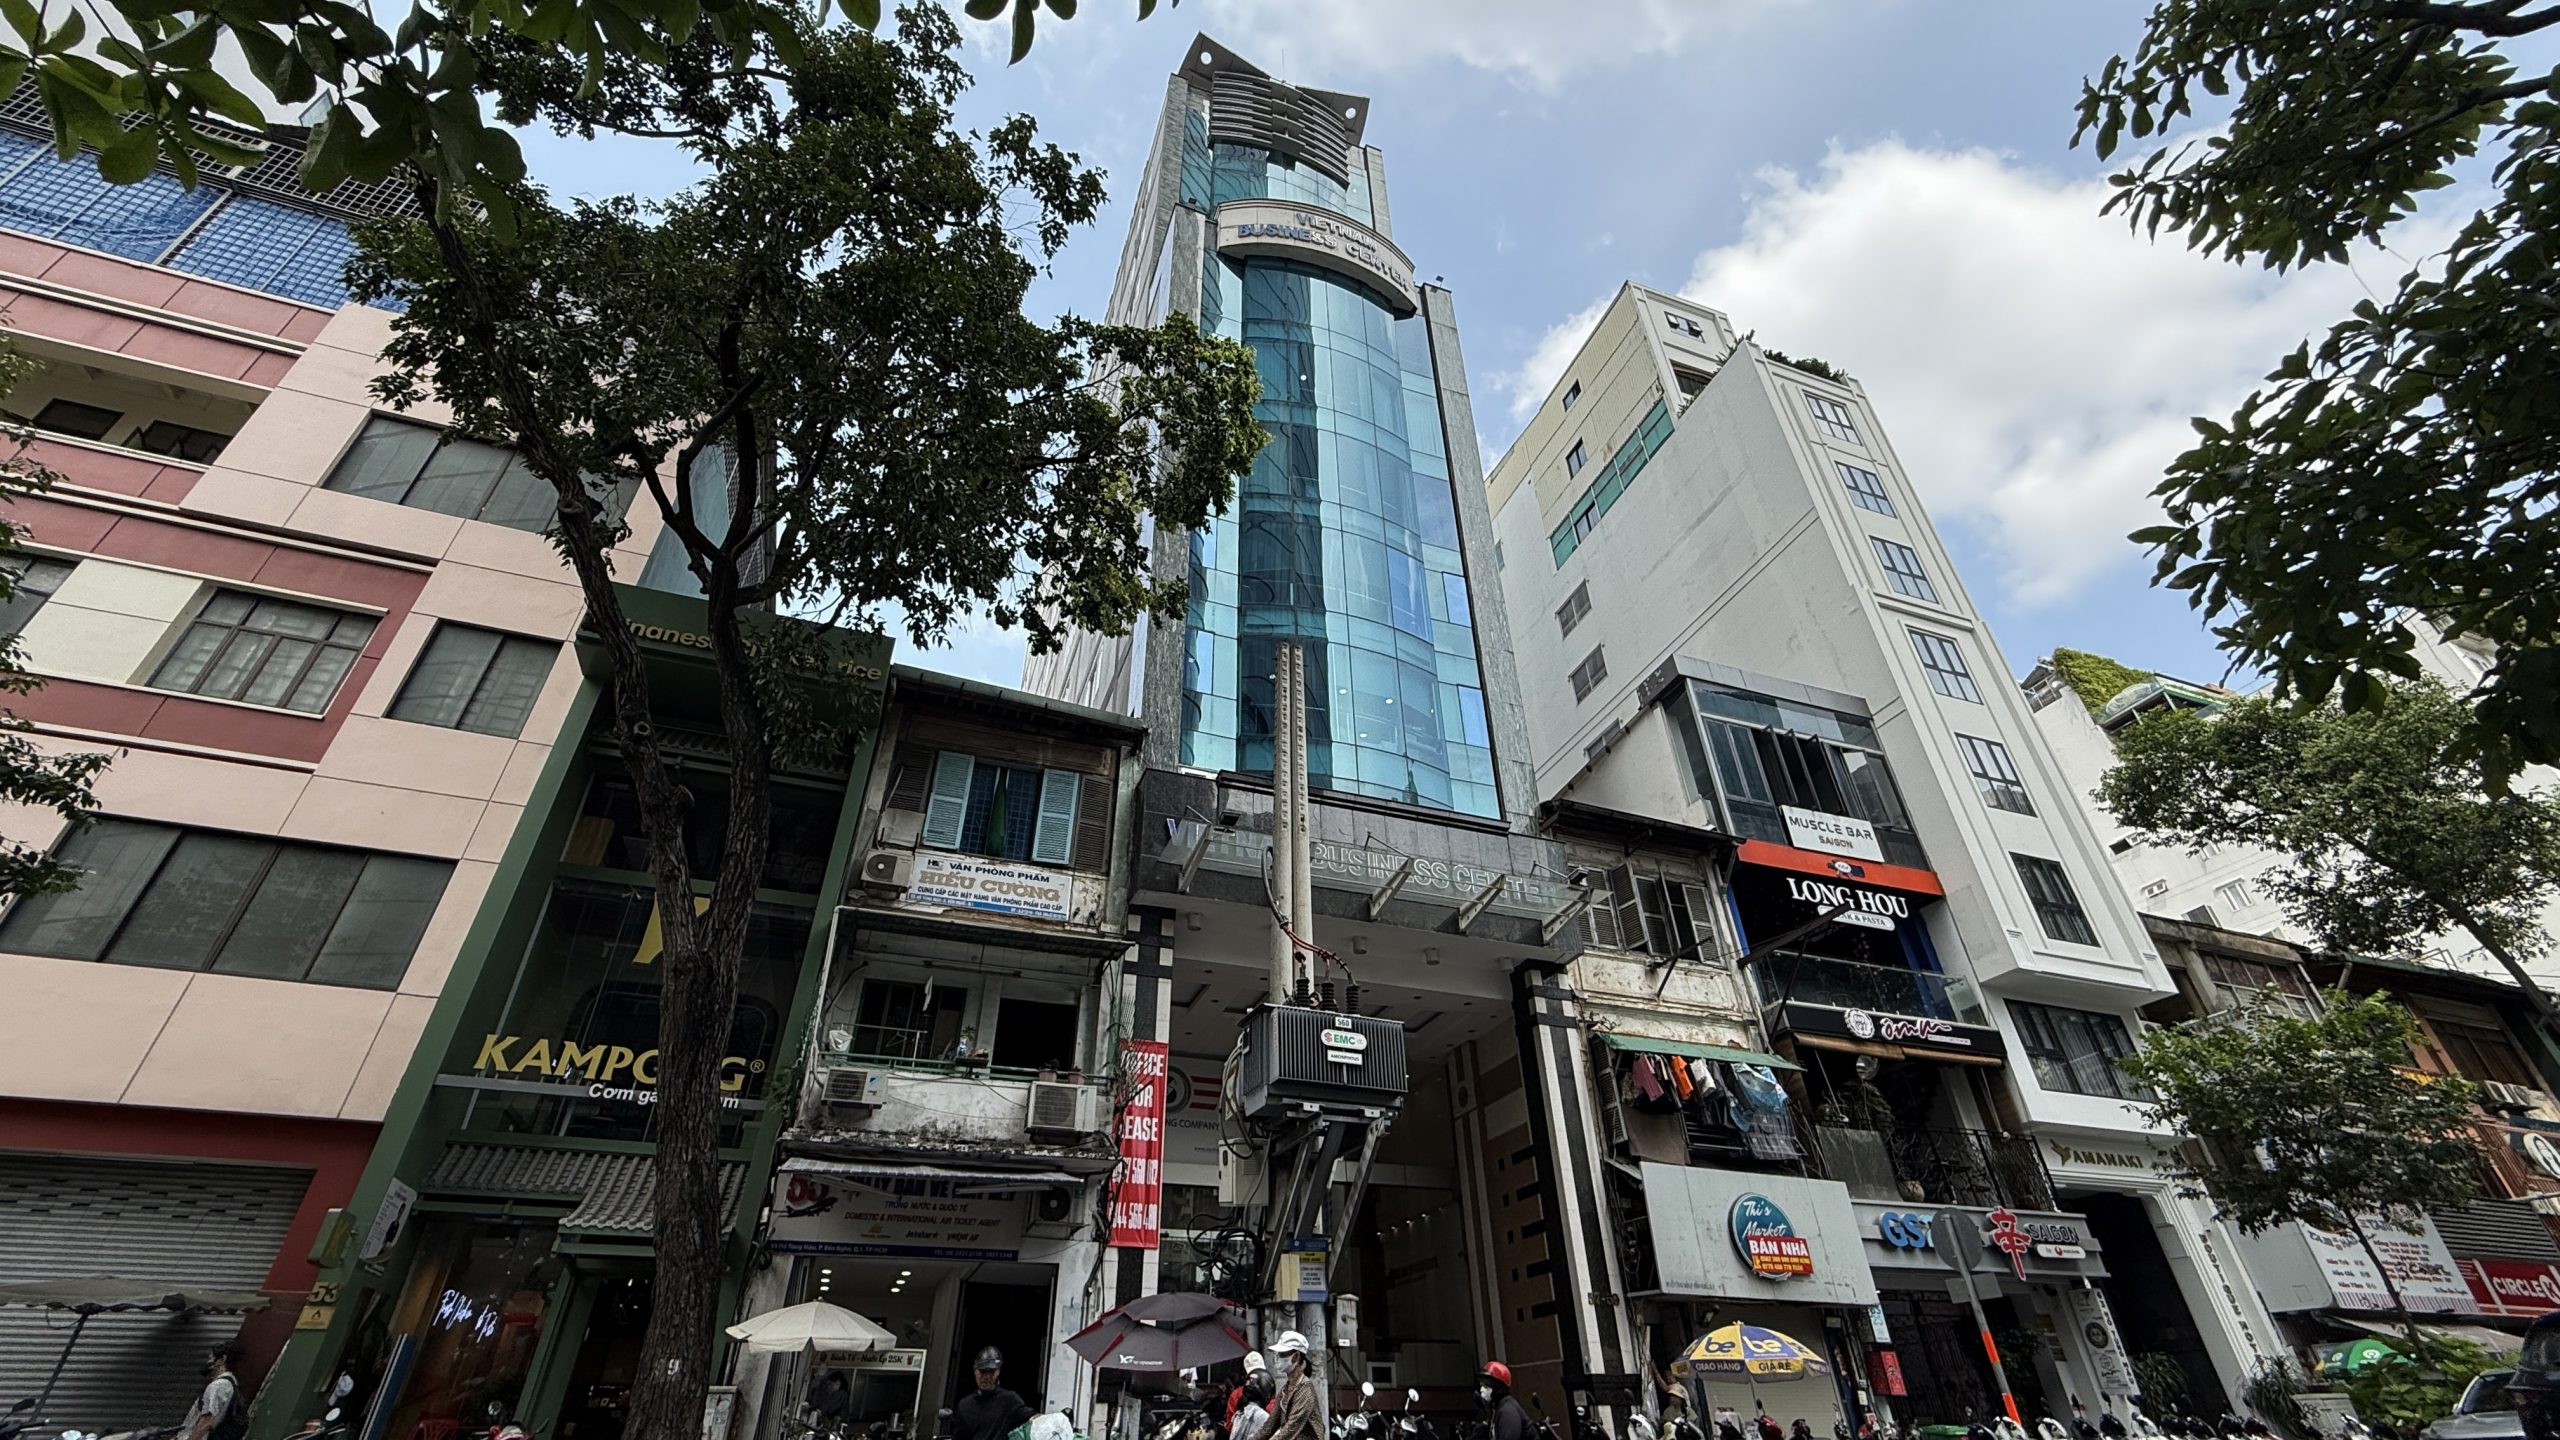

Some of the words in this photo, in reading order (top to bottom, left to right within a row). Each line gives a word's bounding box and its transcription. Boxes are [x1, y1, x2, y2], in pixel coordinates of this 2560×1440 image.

[1296, 212, 1378, 253] VIETNAM
[1238, 223, 1337, 249] BUSINESS
[1345, 242, 1411, 293] CENTER
[838, 661, 882, 681] rice
[1788, 816, 1843, 835] MUSCLE
[1846, 826, 1874, 841] BAR
[1818, 834, 1854, 849] SAIGON
[919, 871, 976, 890] HIẾU
[1786, 877, 1852, 909] LONG
[1854, 892, 1909, 918] HOU
[1863, 916, 1886, 926] PASTA
[1337, 1019, 1350, 1027] 560
[1333, 1034, 1355, 1045] EMC
[473, 1034, 747, 1092] KAMPOG
[588, 1083, 634, 1101] Cơm
[1128, 1083, 1154, 1108] OR
[1178, 1119, 1220, 1131] COMPANY
[2073, 1150, 2143, 1168] AMANAKI
[845, 1212, 878, 1220] DOMESTIC
[887, 1214, 938, 1225] INTERNATIONAL
[940, 1216, 952, 1224] AIR
[954, 1217, 976, 1226] TICKET
[978, 1219, 1001, 1227] AGENT
[1881, 1212, 1935, 1248] GS
[2028, 1224, 2080, 1243] SAIGON
[1749, 1238, 1780, 1255] BÁN
[1781, 1241, 1809, 1256] NHÀ
[2493, 1276, 2541, 1297] CIRCLE
[1705, 1336, 1736, 1354] be
[1743, 1335, 1782, 1353] be
[1695, 1362, 1715, 1370] GIAO
[1716, 1363, 1741, 1371] HÀNG
[1758, 1360, 1775, 1371] GIÁ
